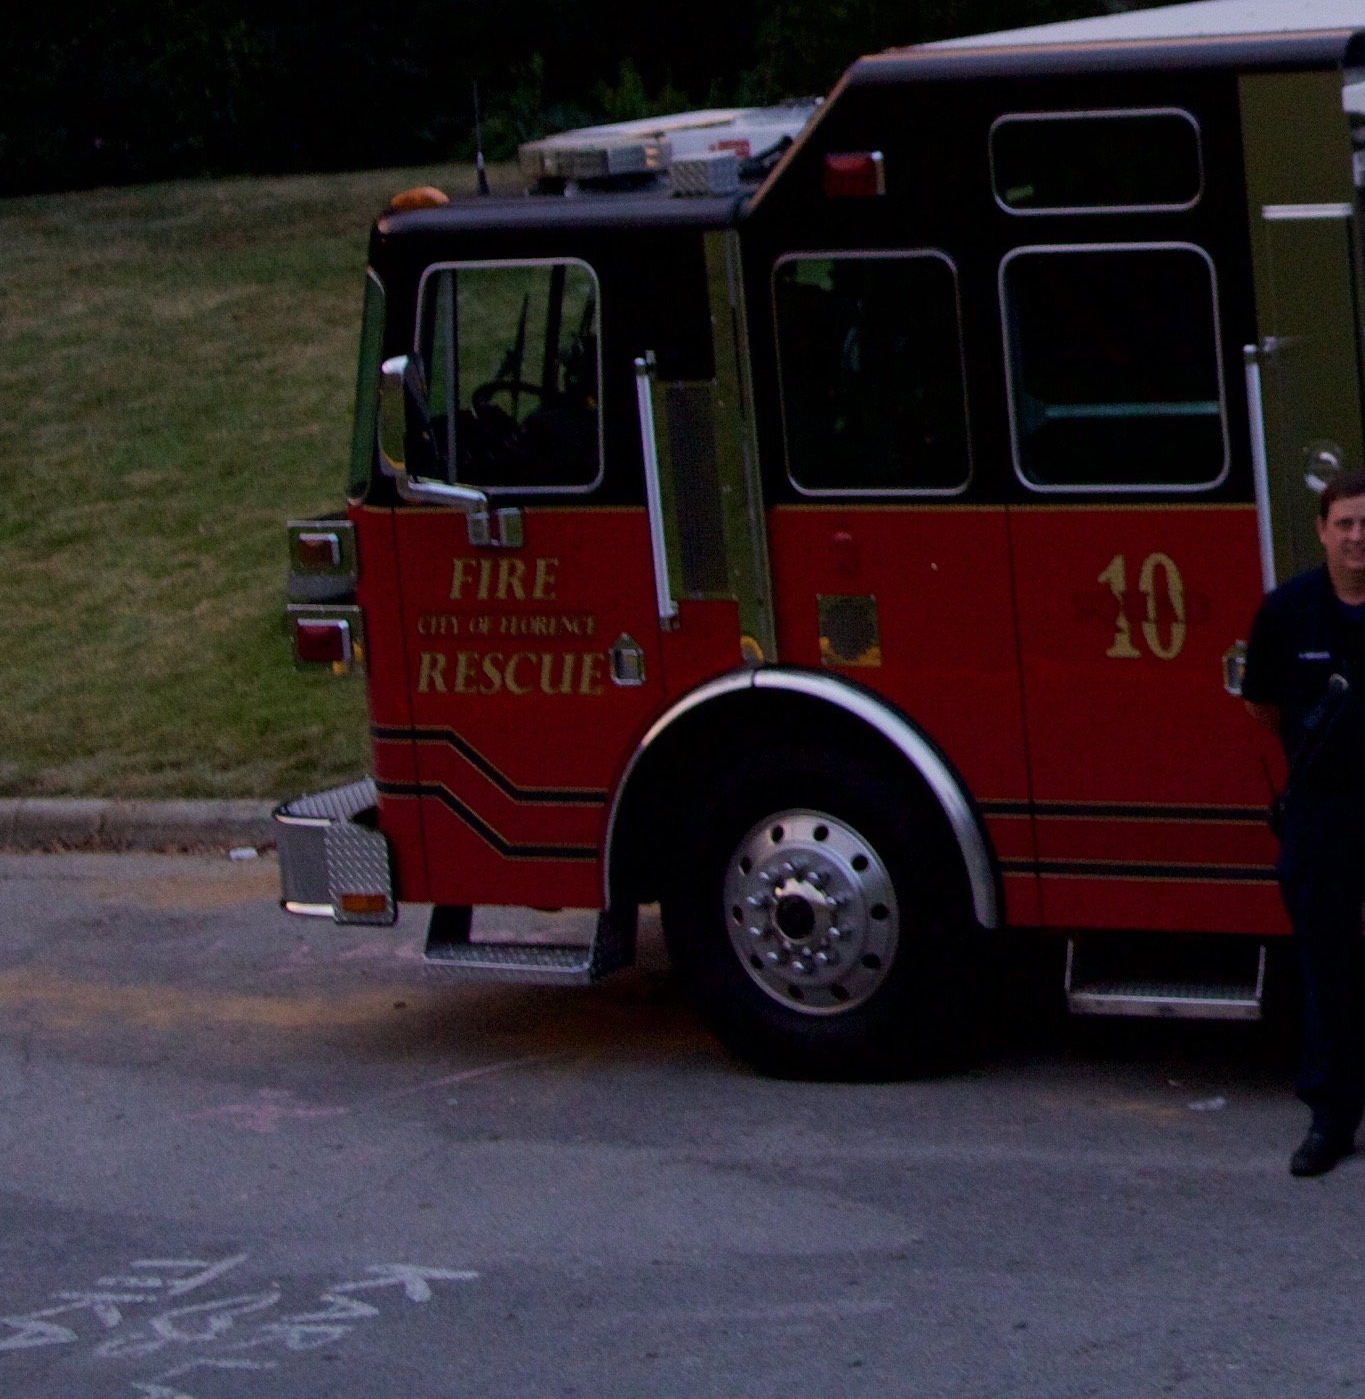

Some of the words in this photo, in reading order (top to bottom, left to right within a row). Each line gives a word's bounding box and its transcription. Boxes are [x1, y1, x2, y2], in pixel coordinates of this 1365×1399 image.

[450, 555, 560, 601] FIRE
[417, 613, 460, 636] CITY
[468, 614, 494, 636] OF
[1097, 551, 1188, 661] 10
[416, 649, 607, 696] RESCUE
